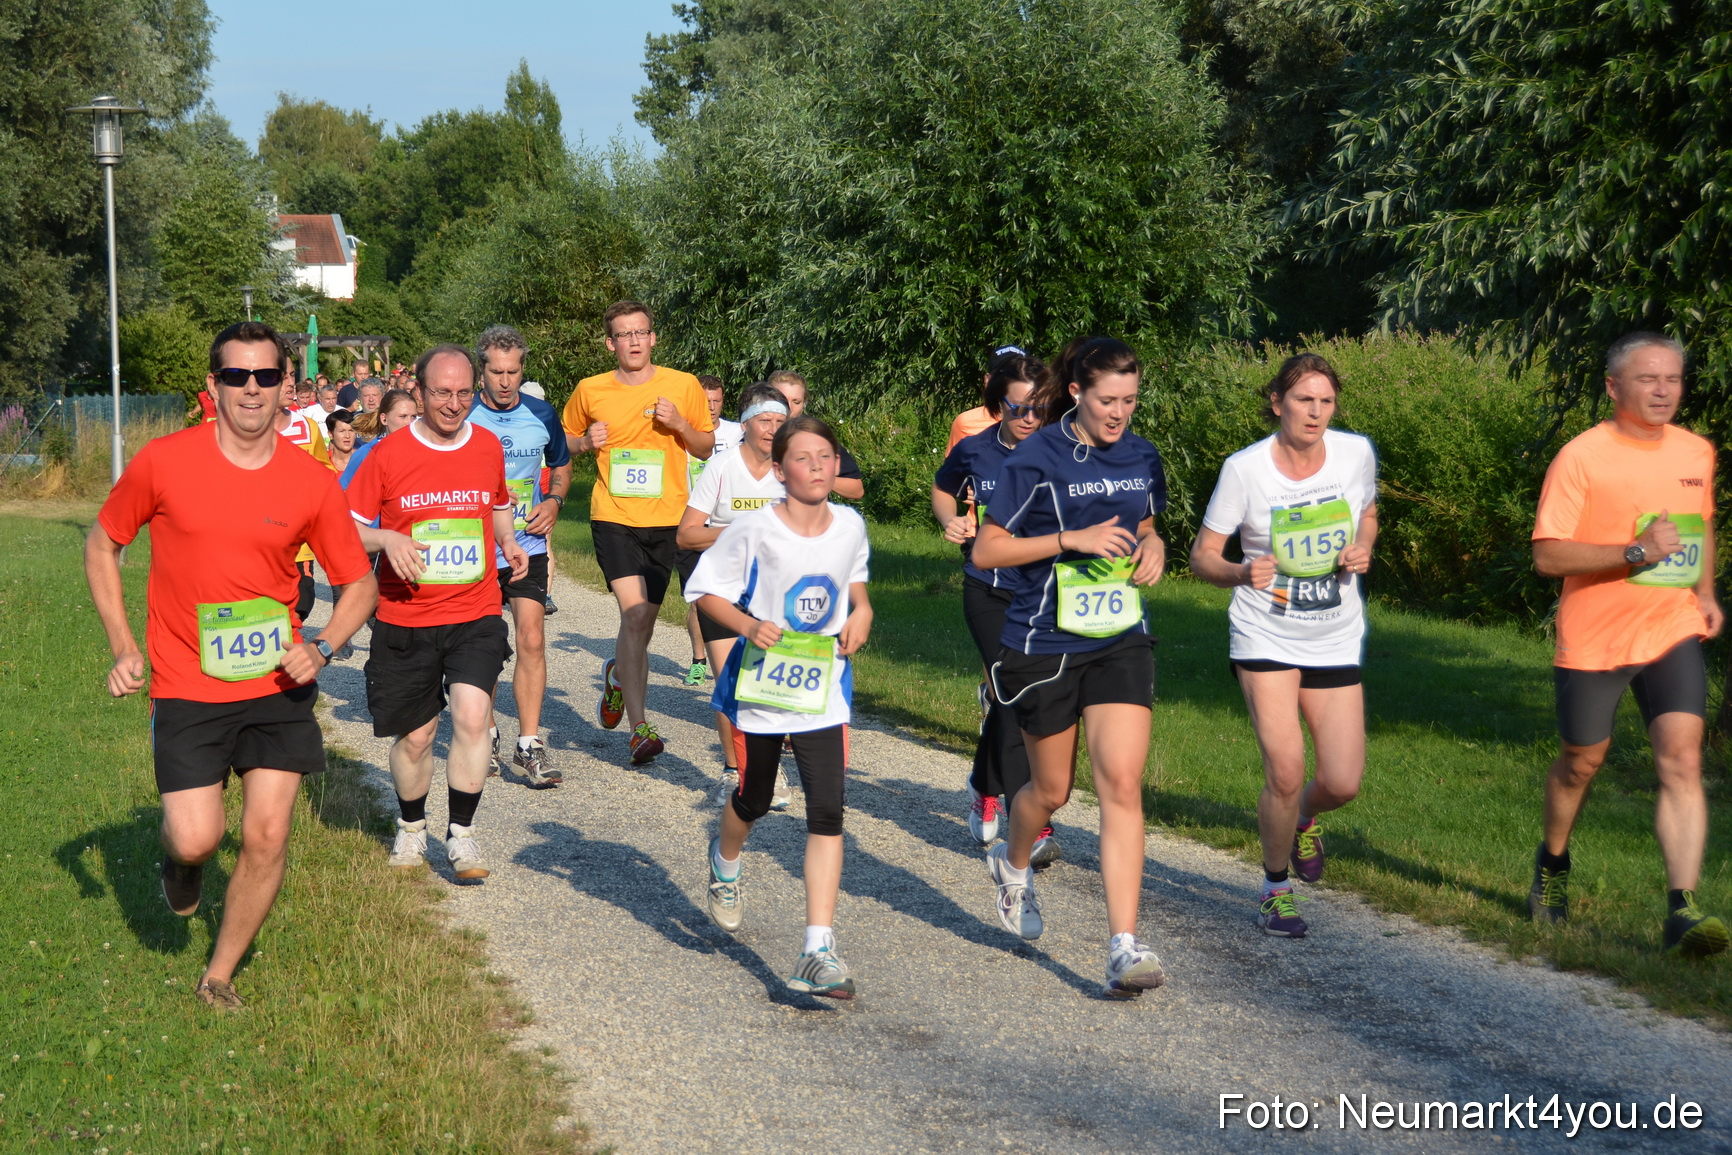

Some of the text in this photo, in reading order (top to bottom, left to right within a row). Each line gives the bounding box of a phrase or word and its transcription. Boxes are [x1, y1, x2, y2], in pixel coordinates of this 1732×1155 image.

[626, 468, 648, 484] 58
[401, 490, 480, 509] NEUMARKT
[733, 498, 769, 509] ONLI
[1280, 492, 1299, 501] NEUE
[1282, 529, 1347, 559] 1153
[421, 545, 479, 566] 1404
[1298, 579, 1331, 601] RW
[1074, 589, 1124, 617] 376
[210, 627, 282, 660] 1491
[752, 657, 822, 692] 1488
